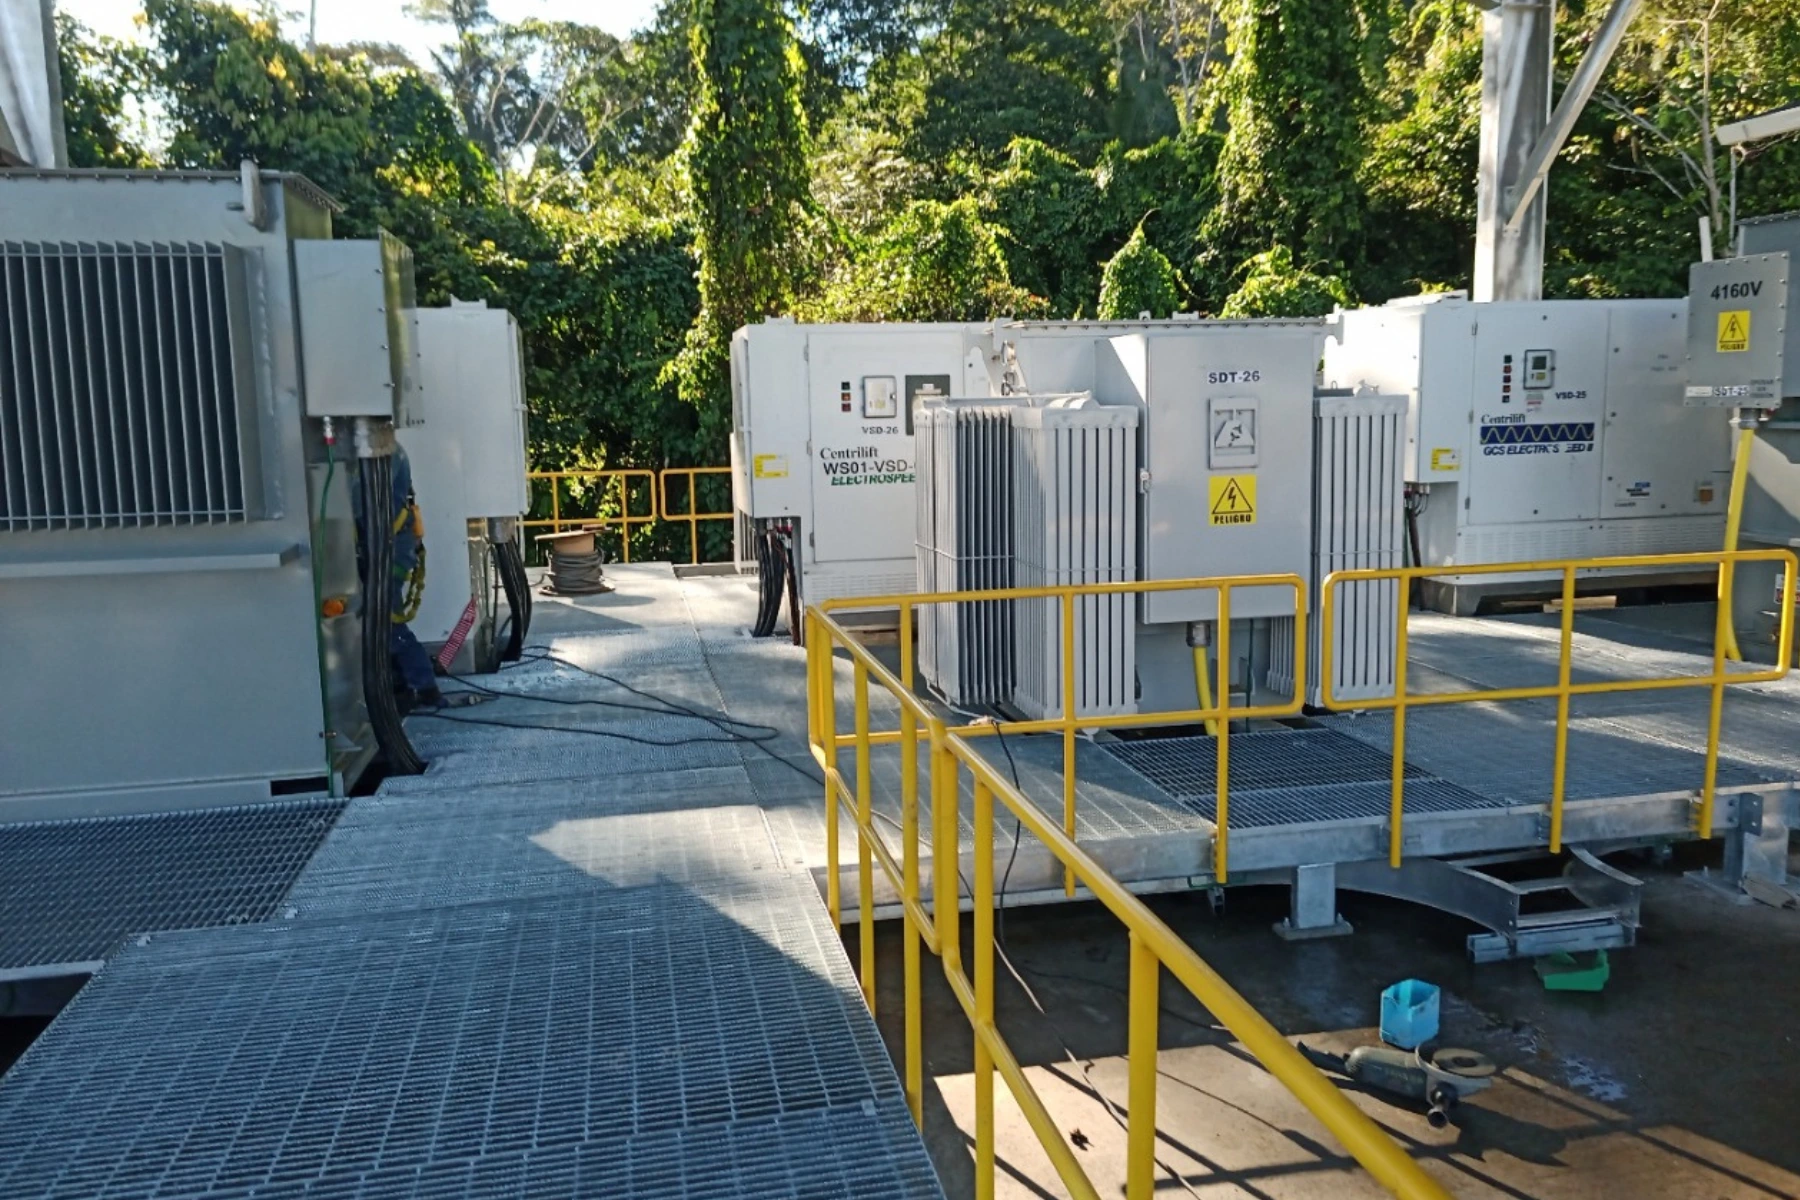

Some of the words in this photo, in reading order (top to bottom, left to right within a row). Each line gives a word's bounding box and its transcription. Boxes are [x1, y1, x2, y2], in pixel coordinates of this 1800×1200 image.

[1710, 280, 1763, 300] 4160V
[1208, 370, 1260, 384] SDT-26
[1555, 390, 1587, 400] VSD-25
[861, 426, 899, 435] VSD-26
[819, 446, 879, 460] Centrilift
[1483, 445, 1506, 456] GCS
[823, 459, 917, 476] WS01-VSD-
[1214, 513, 1252, 525] PELIGRO
